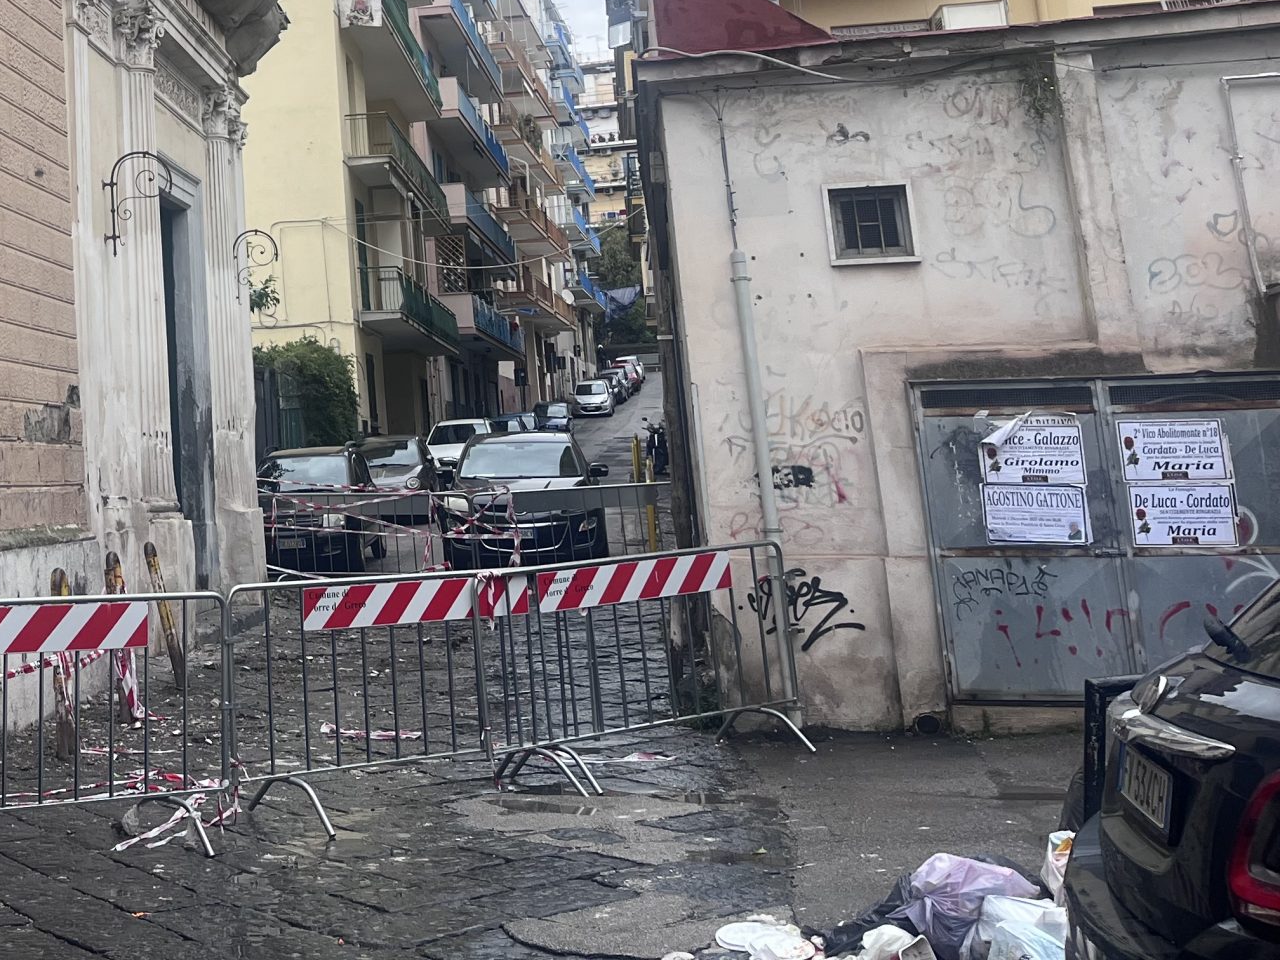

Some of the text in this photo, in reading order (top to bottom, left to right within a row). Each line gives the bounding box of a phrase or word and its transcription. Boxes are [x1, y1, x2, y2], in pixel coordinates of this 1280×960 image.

[1142, 428, 1156, 438] Vico
[1002, 436, 1024, 446] nce
[1034, 431, 1079, 446] Galazzo
[1142, 445, 1178, 454] Cordato
[1185, 445, 1196, 454] De
[1198, 445, 1219, 454] Luca
[1004, 458, 1080, 466] Girolamo
[1152, 460, 1215, 470] Maria
[987, 491, 1082, 508] AGOSTINO GATTONE
[1134, 494, 1148, 508] De
[1152, 494, 1176, 508] Luca
[1186, 493, 1230, 508] Cordato
[1167, 525, 1217, 536] Maria
[544, 576, 570, 585] Comune
[309, 591, 340, 600] Comune
